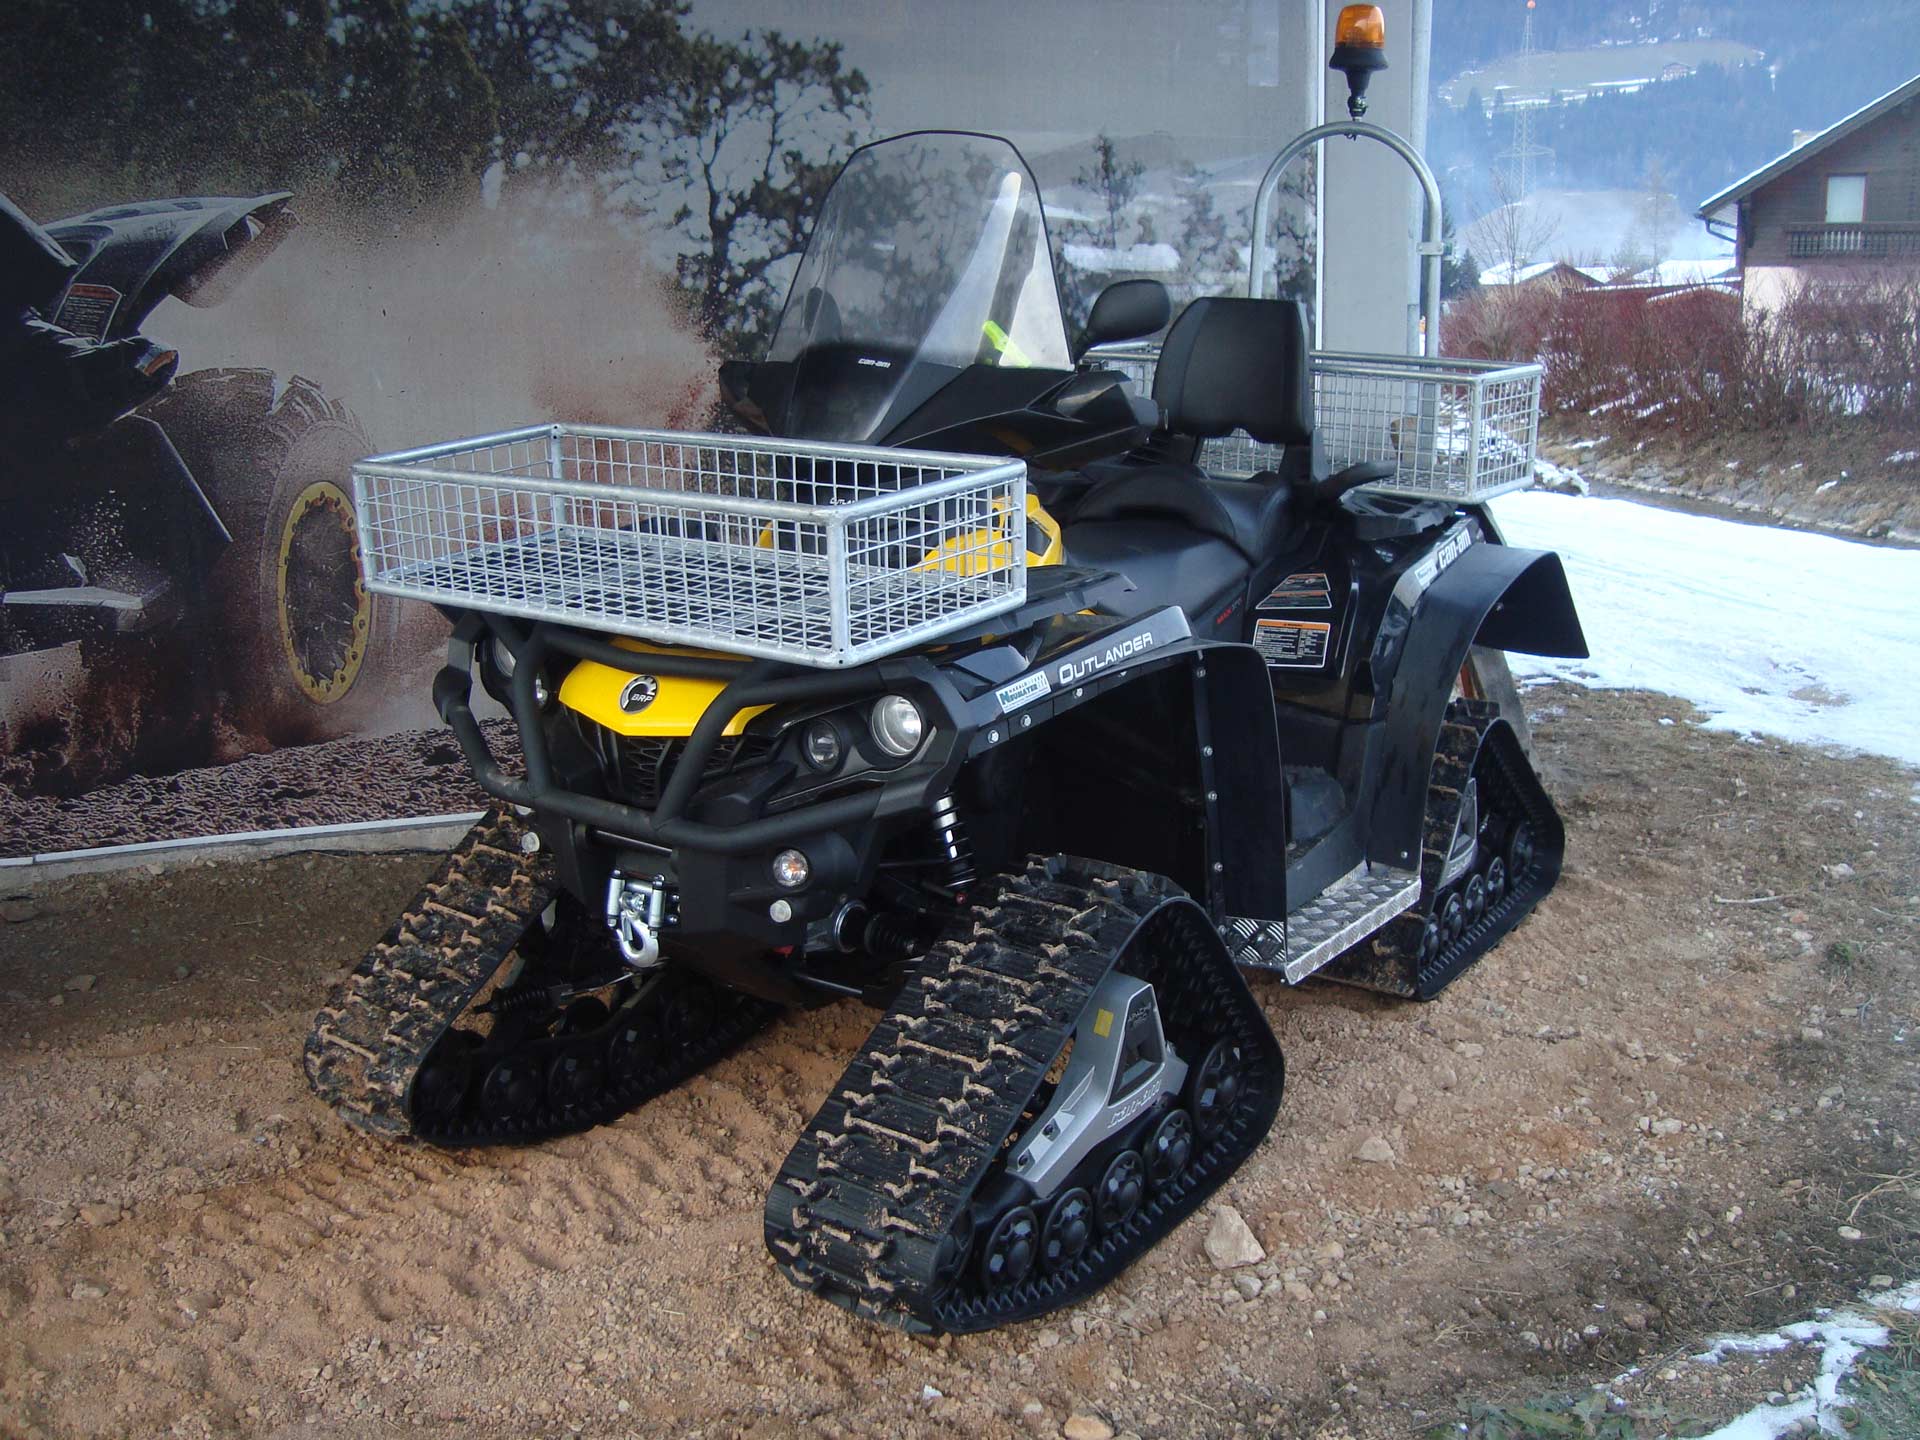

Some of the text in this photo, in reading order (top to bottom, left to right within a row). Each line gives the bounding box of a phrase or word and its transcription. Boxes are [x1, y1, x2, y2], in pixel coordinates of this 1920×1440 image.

[1438, 527, 1472, 570] can-am
[1059, 632, 1153, 684] OUTLANDER
[631, 693, 654, 703] BRP
